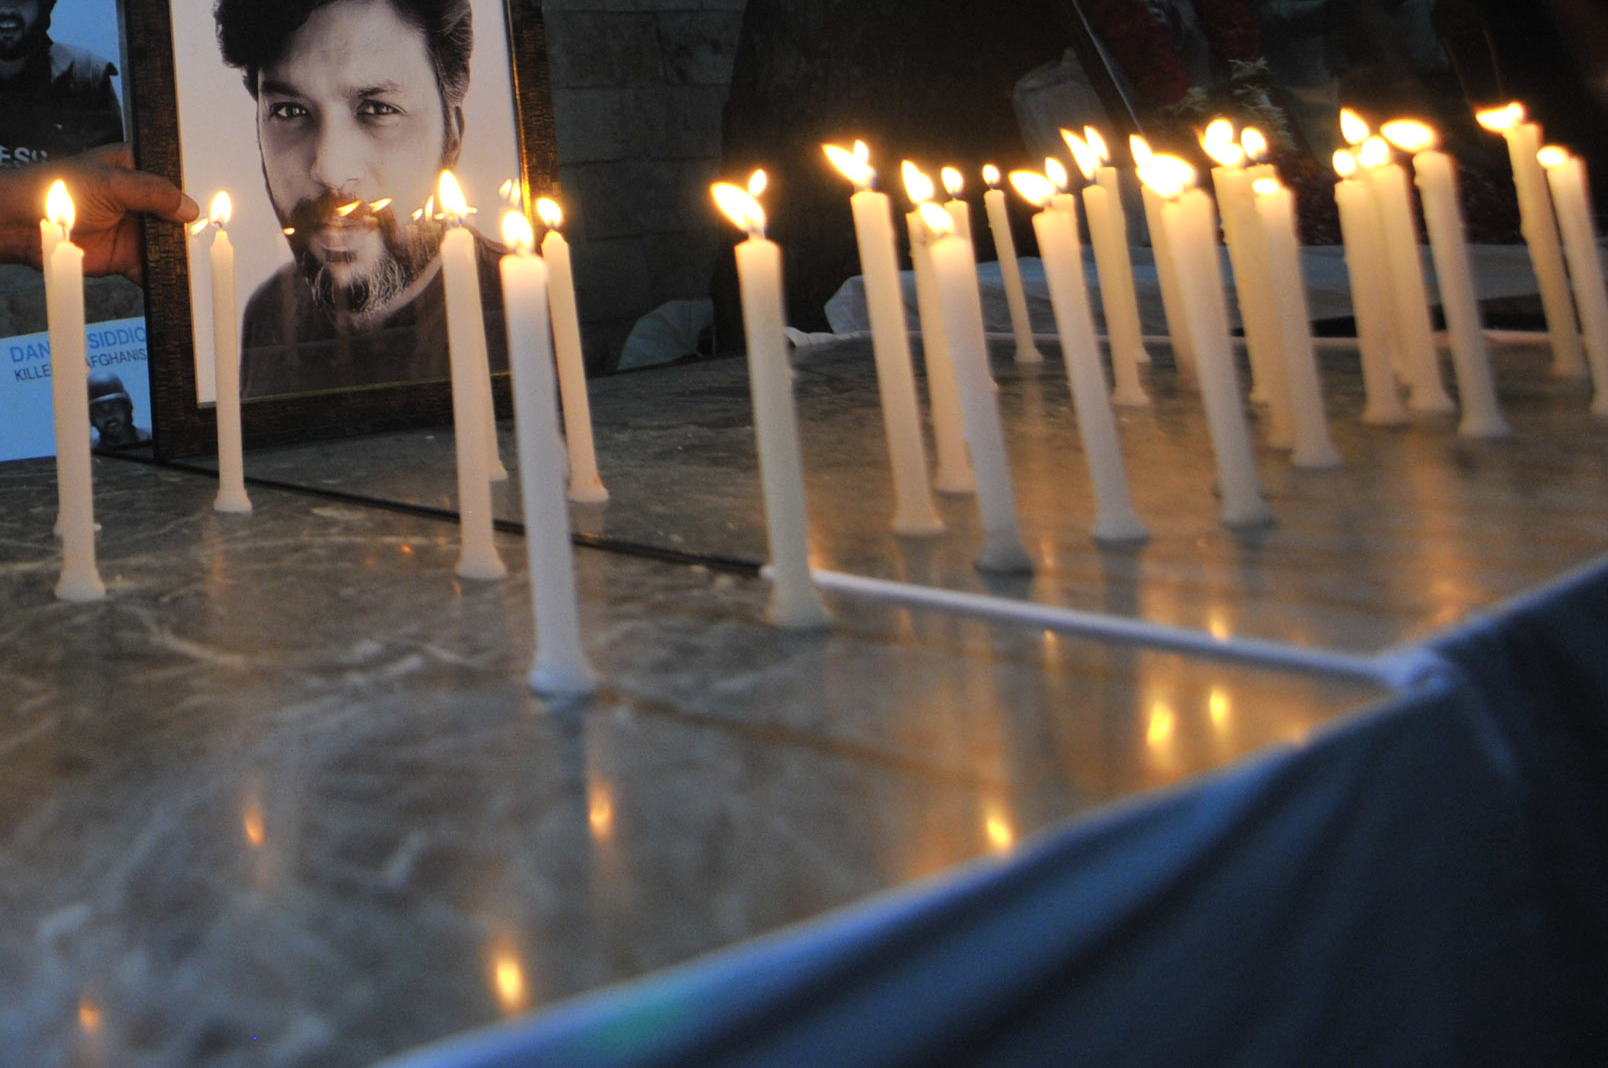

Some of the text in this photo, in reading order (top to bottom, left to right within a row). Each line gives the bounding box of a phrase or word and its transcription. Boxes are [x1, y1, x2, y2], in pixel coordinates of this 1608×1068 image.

[9, 326, 146, 363] DAN SIDDIQ
[13, 347, 148, 382] KILLE FGHANIS
